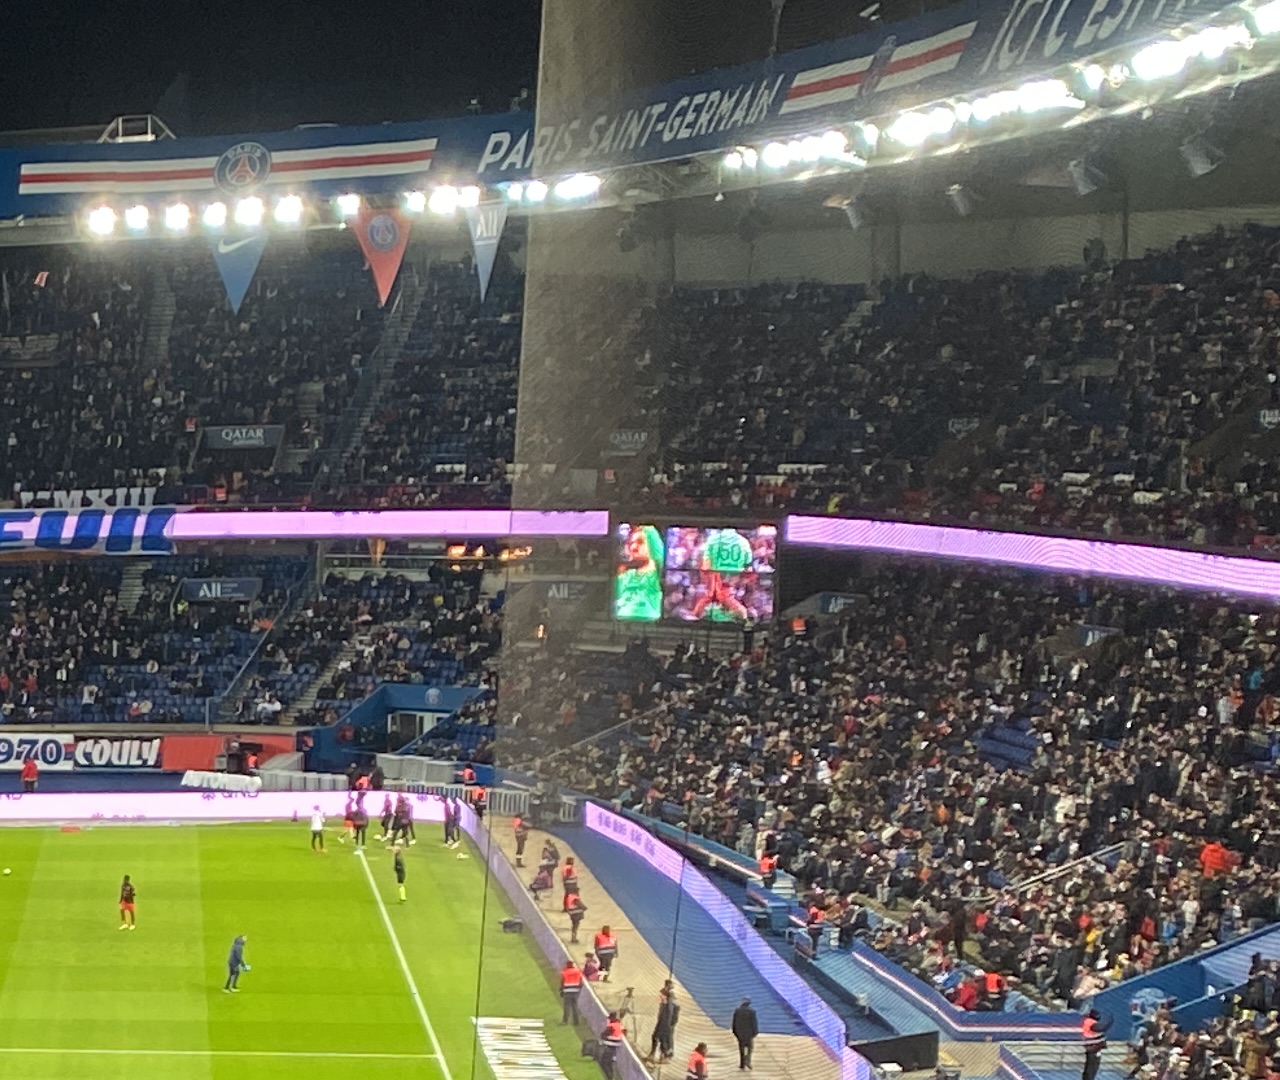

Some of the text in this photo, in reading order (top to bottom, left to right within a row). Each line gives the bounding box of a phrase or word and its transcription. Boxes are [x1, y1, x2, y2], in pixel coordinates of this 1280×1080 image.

[477, 73, 785, 174] PARIS SAINT-GERMAIN
[221, 429, 265, 442] QATAR
